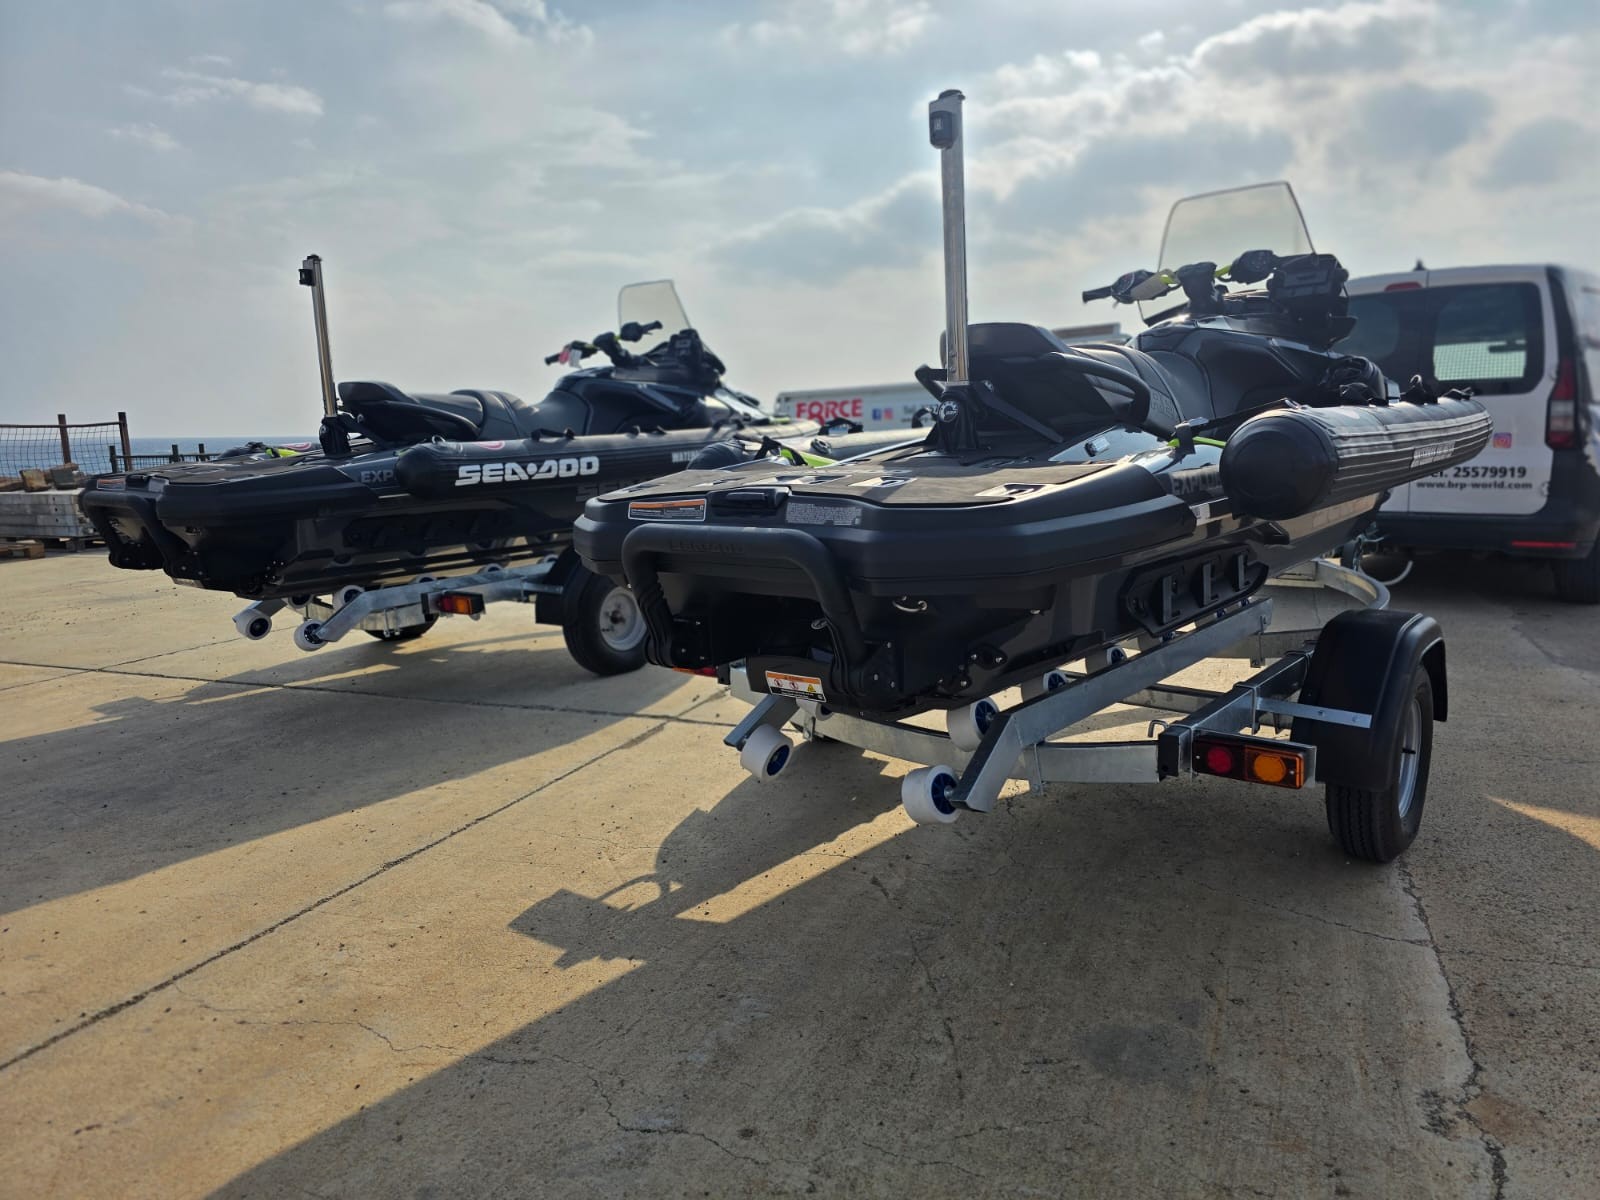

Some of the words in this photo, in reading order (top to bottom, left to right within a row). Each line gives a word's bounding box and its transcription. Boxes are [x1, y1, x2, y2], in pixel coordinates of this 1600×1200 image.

[796, 399, 863, 425] FORCE
[1453, 466, 1527, 478] 25579919
[1416, 480, 1533, 490] www.brp-world.com
